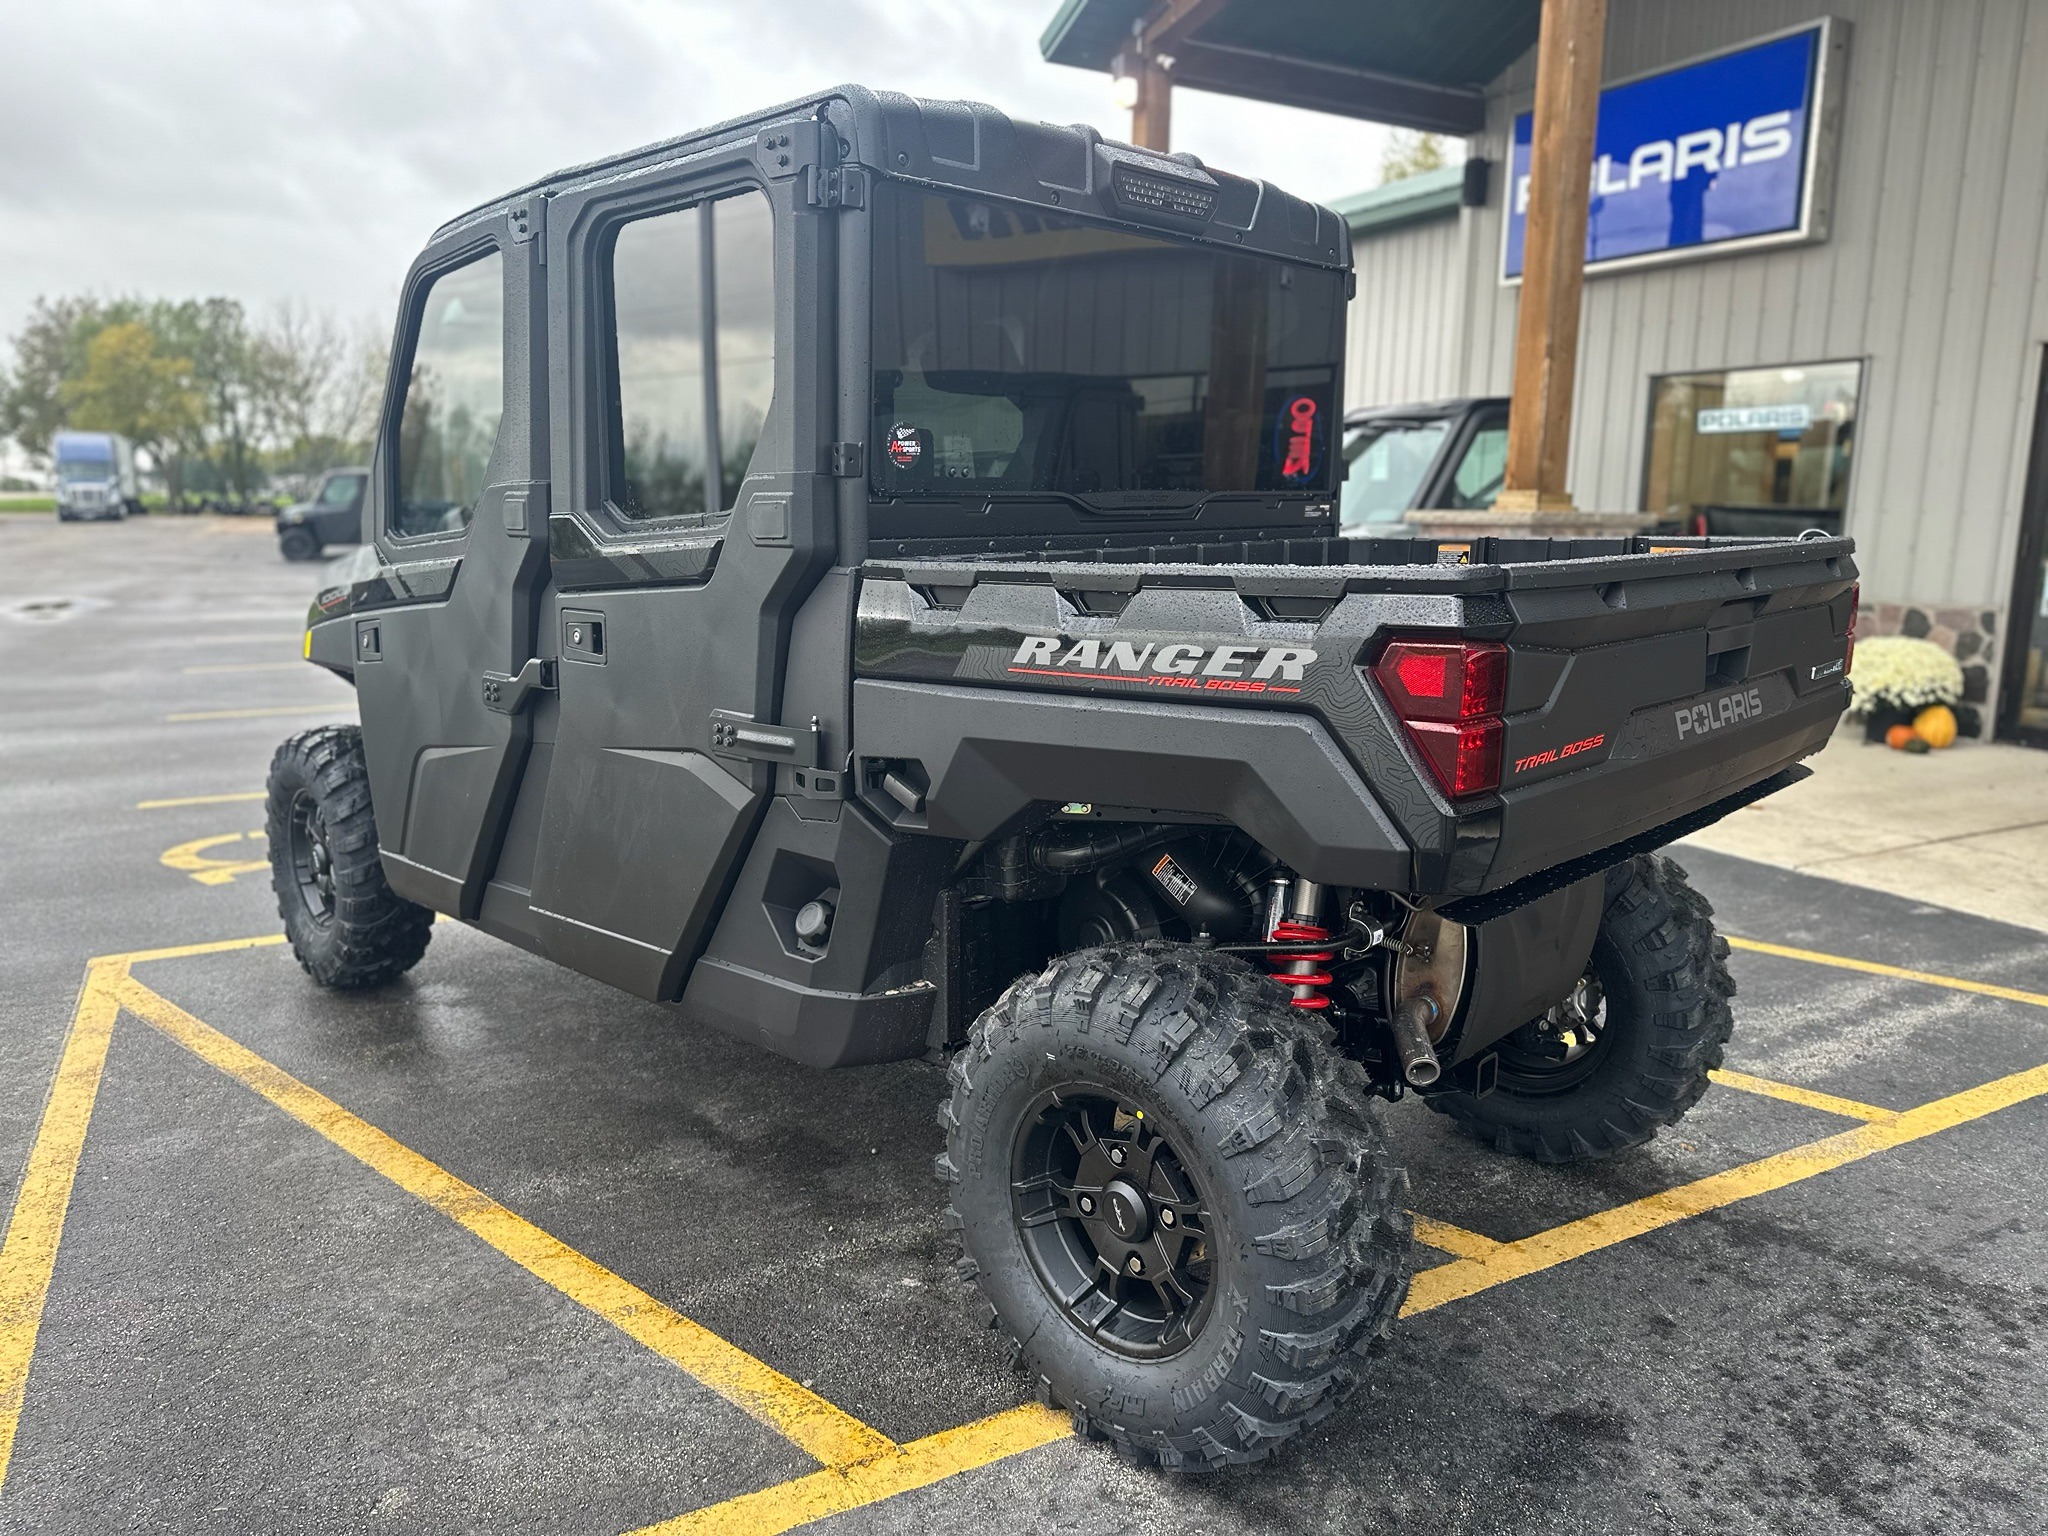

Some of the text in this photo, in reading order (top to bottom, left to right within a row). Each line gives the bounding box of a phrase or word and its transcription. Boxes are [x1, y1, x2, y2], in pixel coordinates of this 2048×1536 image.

[1515, 110, 1793, 215] PLARIS
[1012, 636, 1317, 681] RANGER
[1146, 674, 1269, 693] TRAIL BOSS
[1674, 687, 1763, 741] POLARIS
[1515, 733, 1606, 774] TRAIL BOSS
[967, 1134, 988, 1179] PRO
[1172, 1285, 1250, 1414] X-TERRAIN
